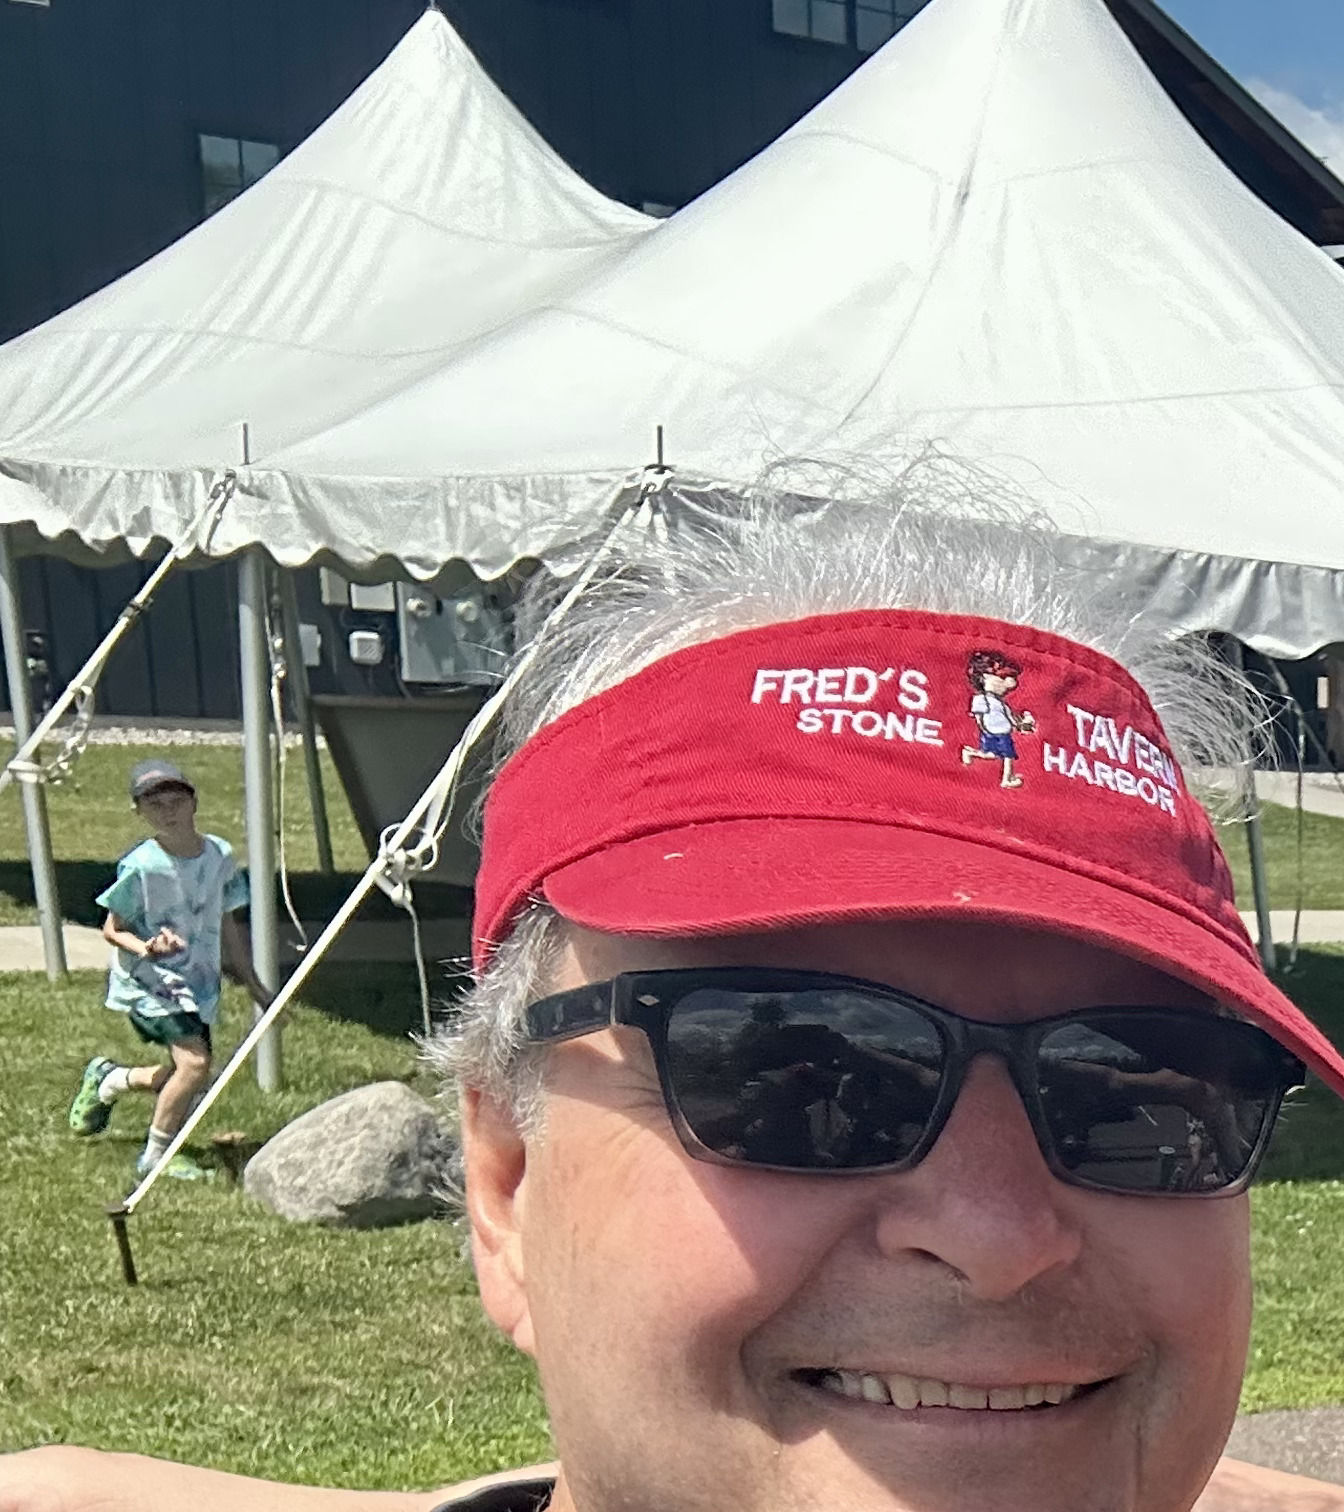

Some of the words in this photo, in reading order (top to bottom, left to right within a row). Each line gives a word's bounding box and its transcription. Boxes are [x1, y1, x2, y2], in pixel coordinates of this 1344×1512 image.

[751, 666, 930, 712] FRED'S
[796, 708, 945, 748] STONE
[1043, 741, 1177, 818] HARBOR
